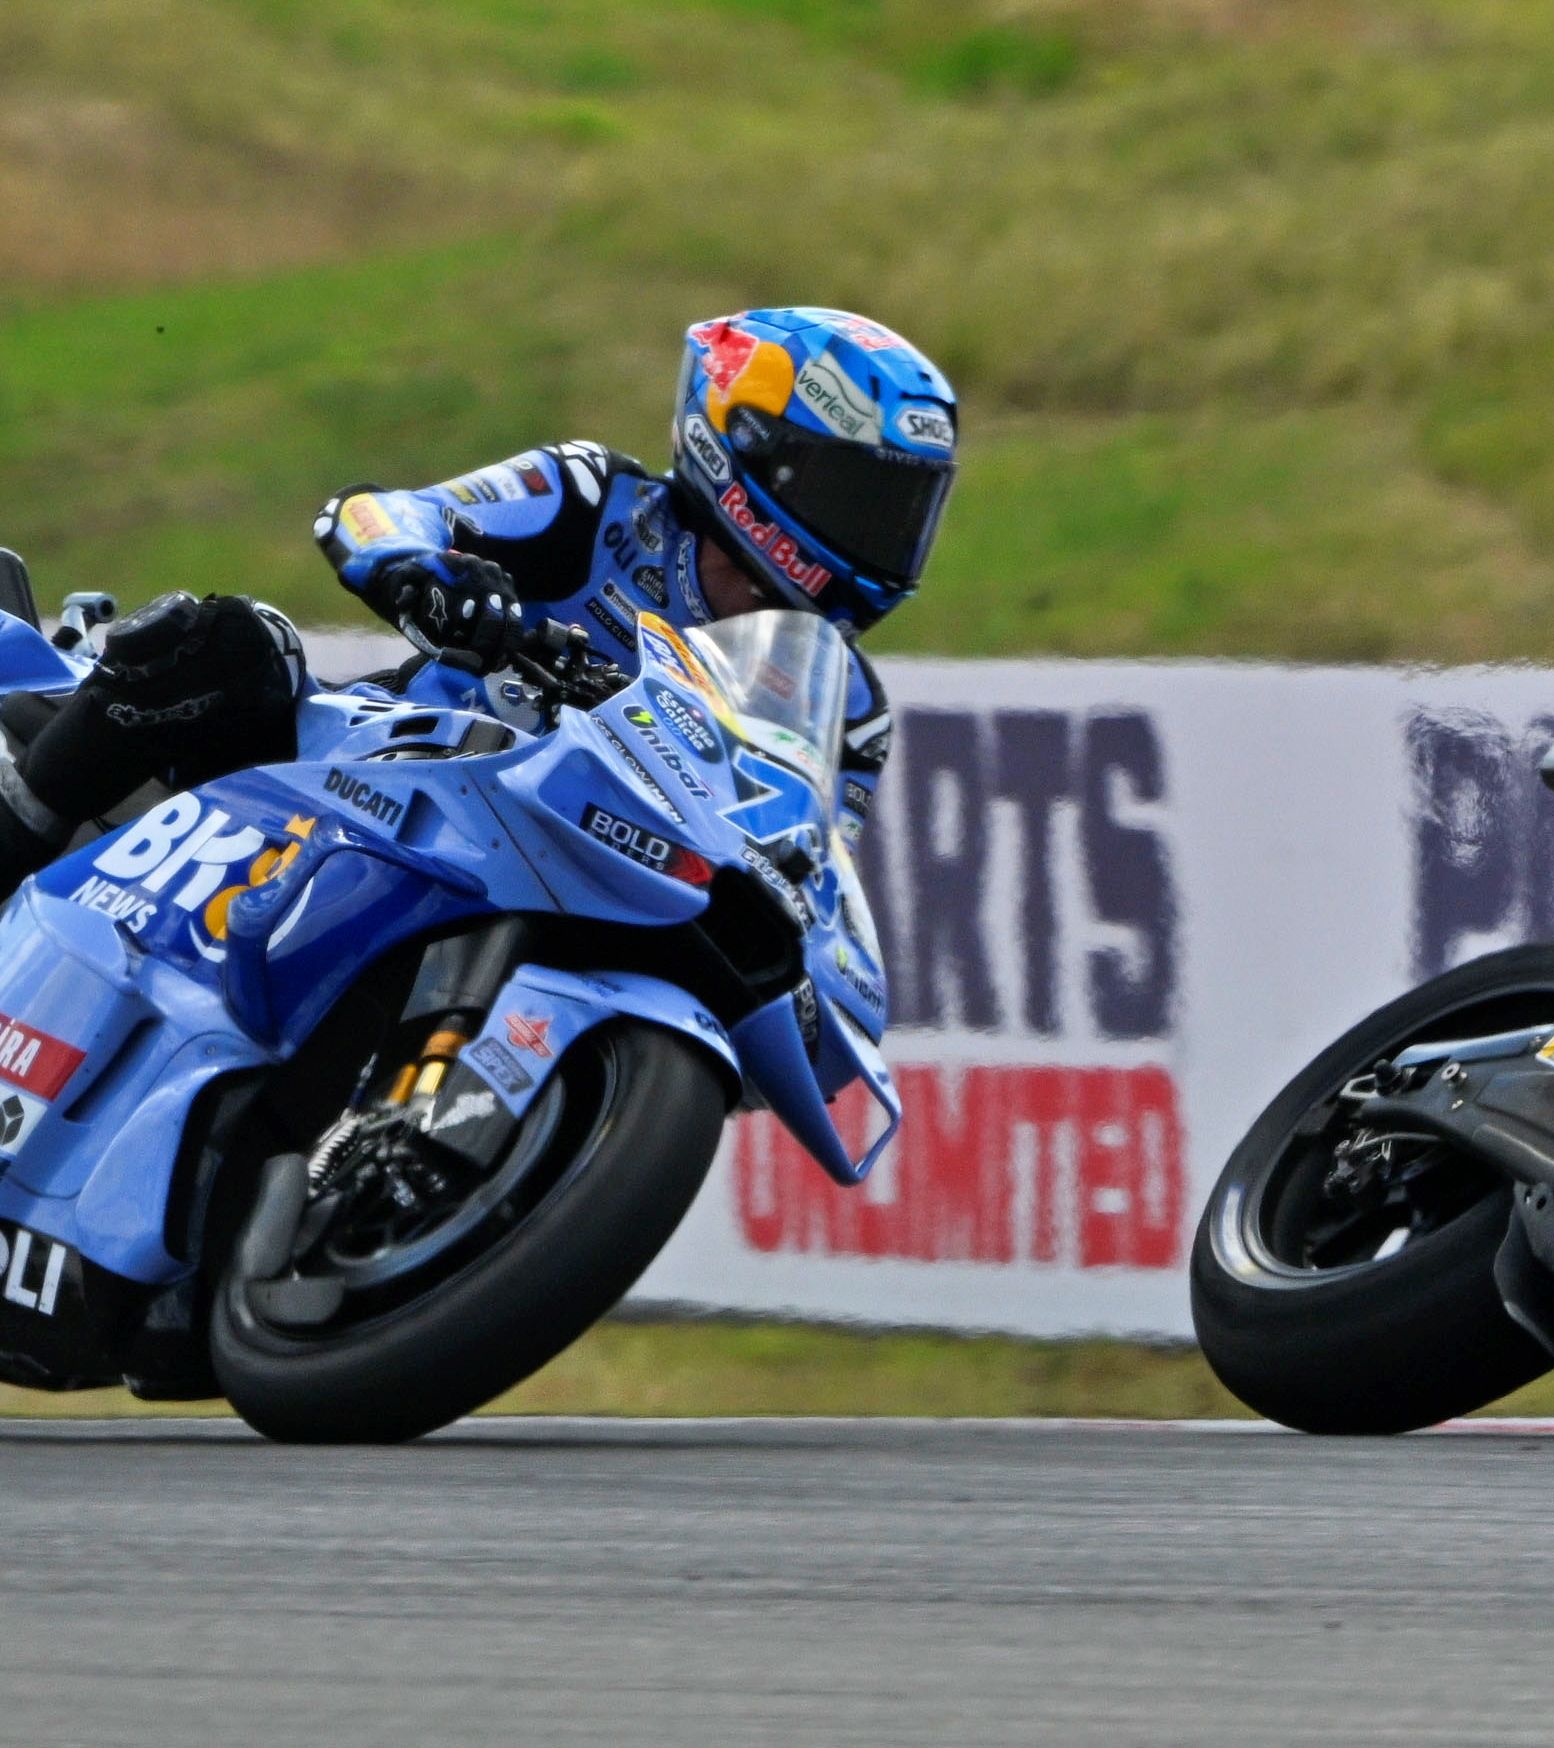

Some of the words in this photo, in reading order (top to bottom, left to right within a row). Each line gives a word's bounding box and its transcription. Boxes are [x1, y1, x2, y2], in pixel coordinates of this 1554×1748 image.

[719, 482, 779, 548] Red
[768, 531, 833, 598] Bull
[655, 694, 705, 751] Galicia
[323, 766, 404, 827] DUCATI
[591, 810, 670, 861] BOLD
[860, 705, 1179, 1039] RTS
[69, 875, 158, 935] NEWS
